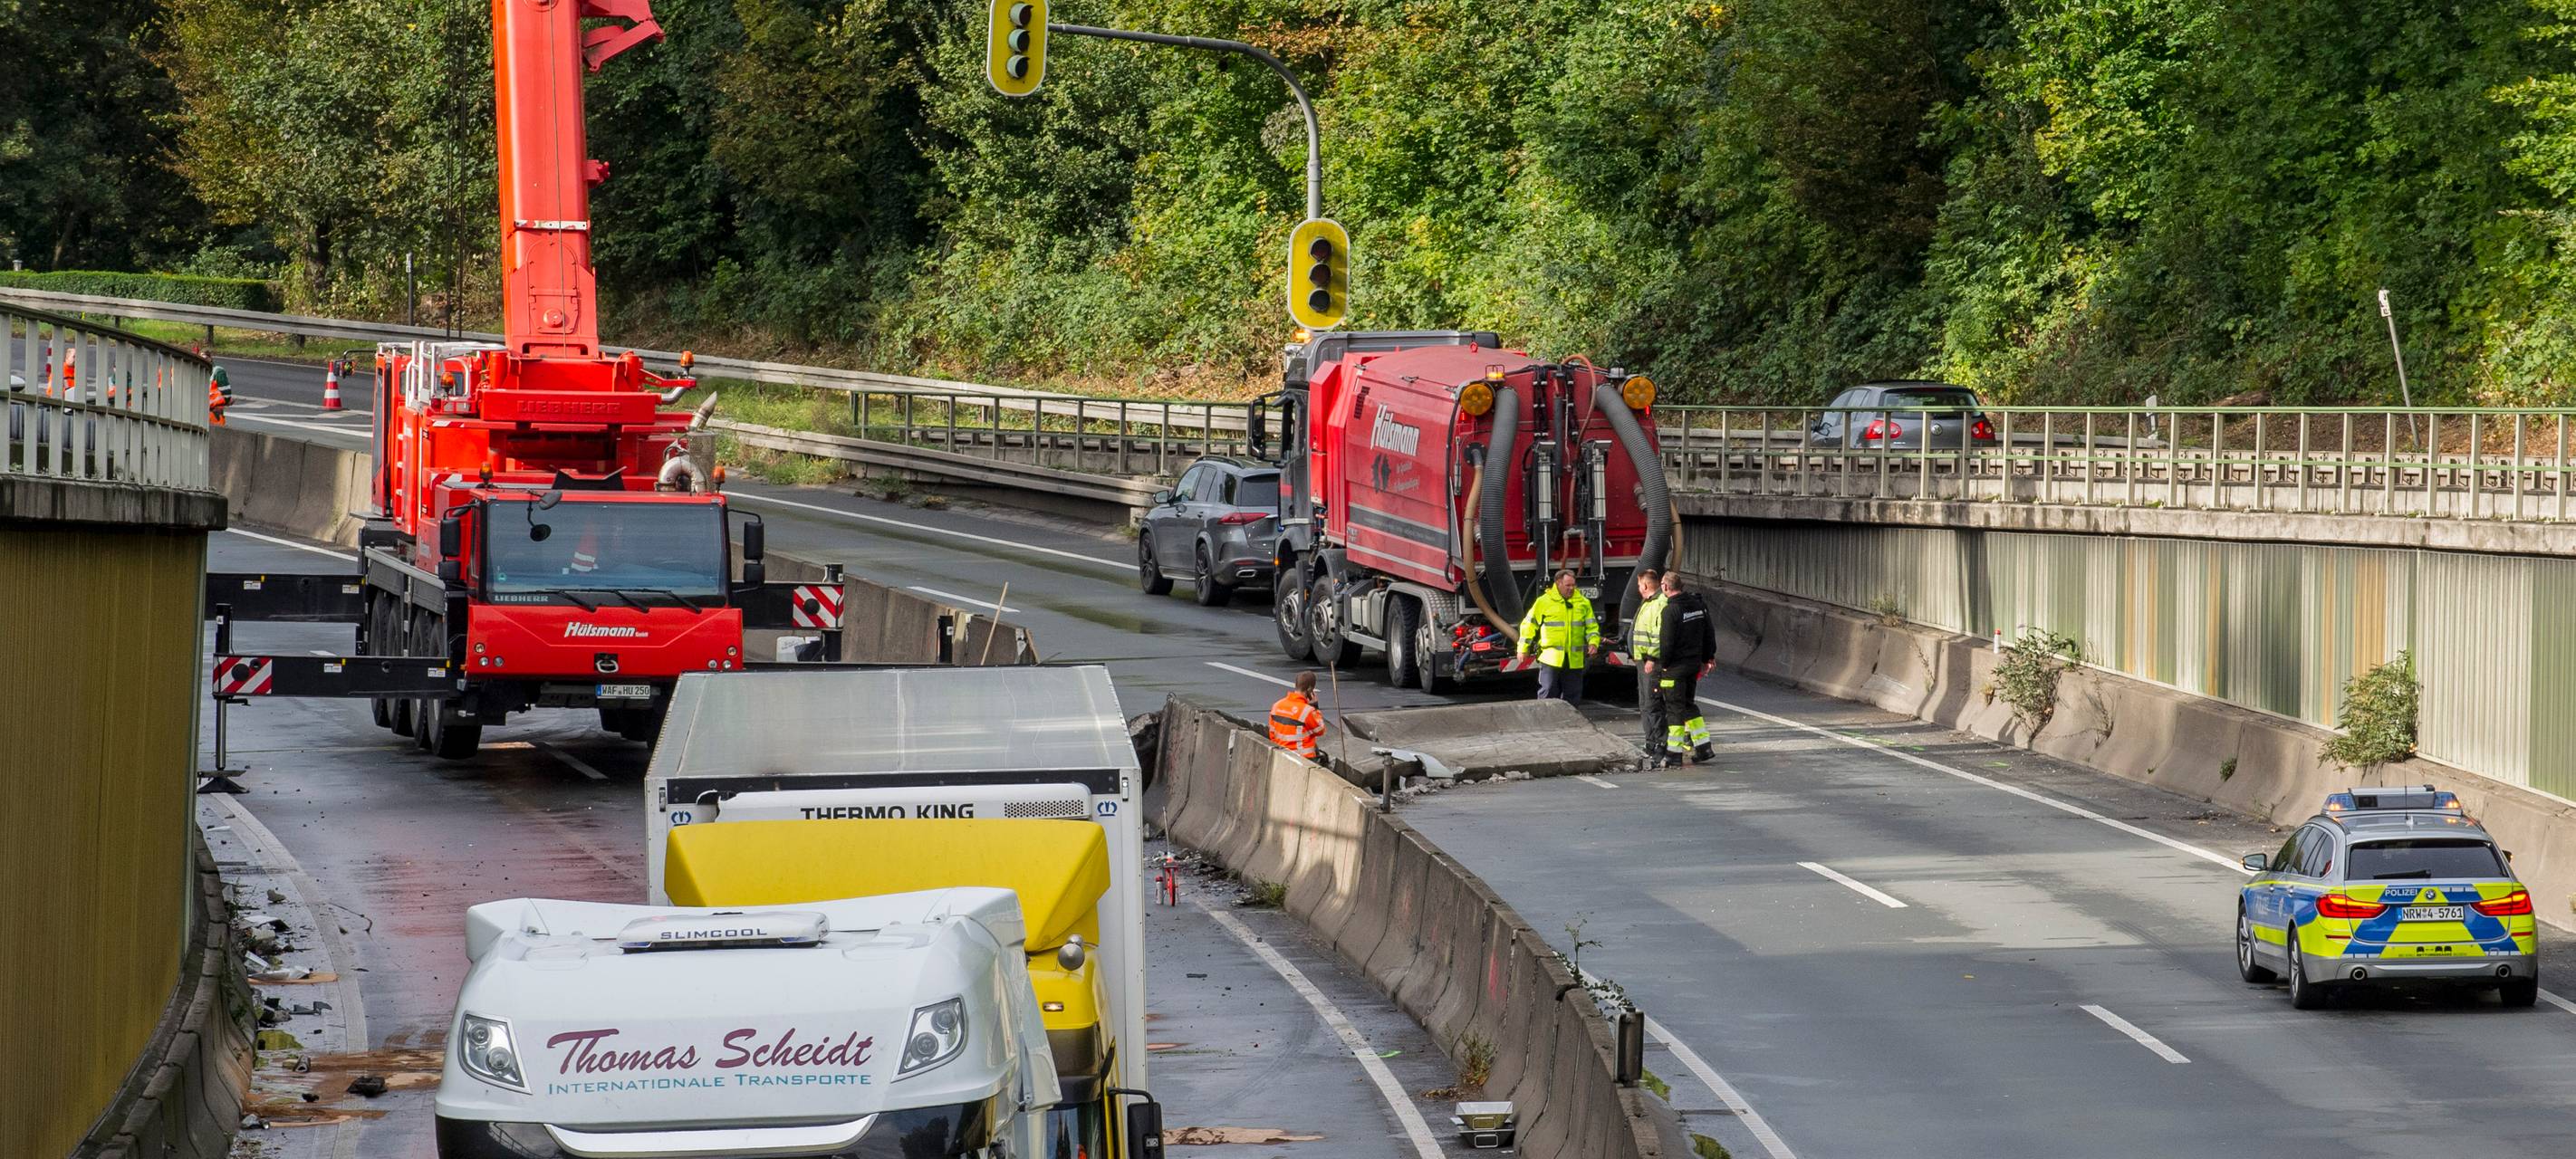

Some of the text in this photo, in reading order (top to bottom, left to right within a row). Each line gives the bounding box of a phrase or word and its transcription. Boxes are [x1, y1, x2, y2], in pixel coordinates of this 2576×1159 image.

[517, 399, 622, 414] LIEBHERR
[1370, 404, 1420, 456] Hülsmann
[495, 594, 549, 602] LIEBHERR
[563, 621, 636, 637] Hülsmann
[601, 685, 649, 695] WAF HU 250
[800, 803, 975, 820] THERMO KING
[2385, 888, 2418, 896] POLIZEI
[2403, 908, 2422, 919] NRW
[546, 1027, 874, 1075] Thomas Scheidt
[549, 1074, 872, 1095] INTERNATIONALE TRANSPORTE
